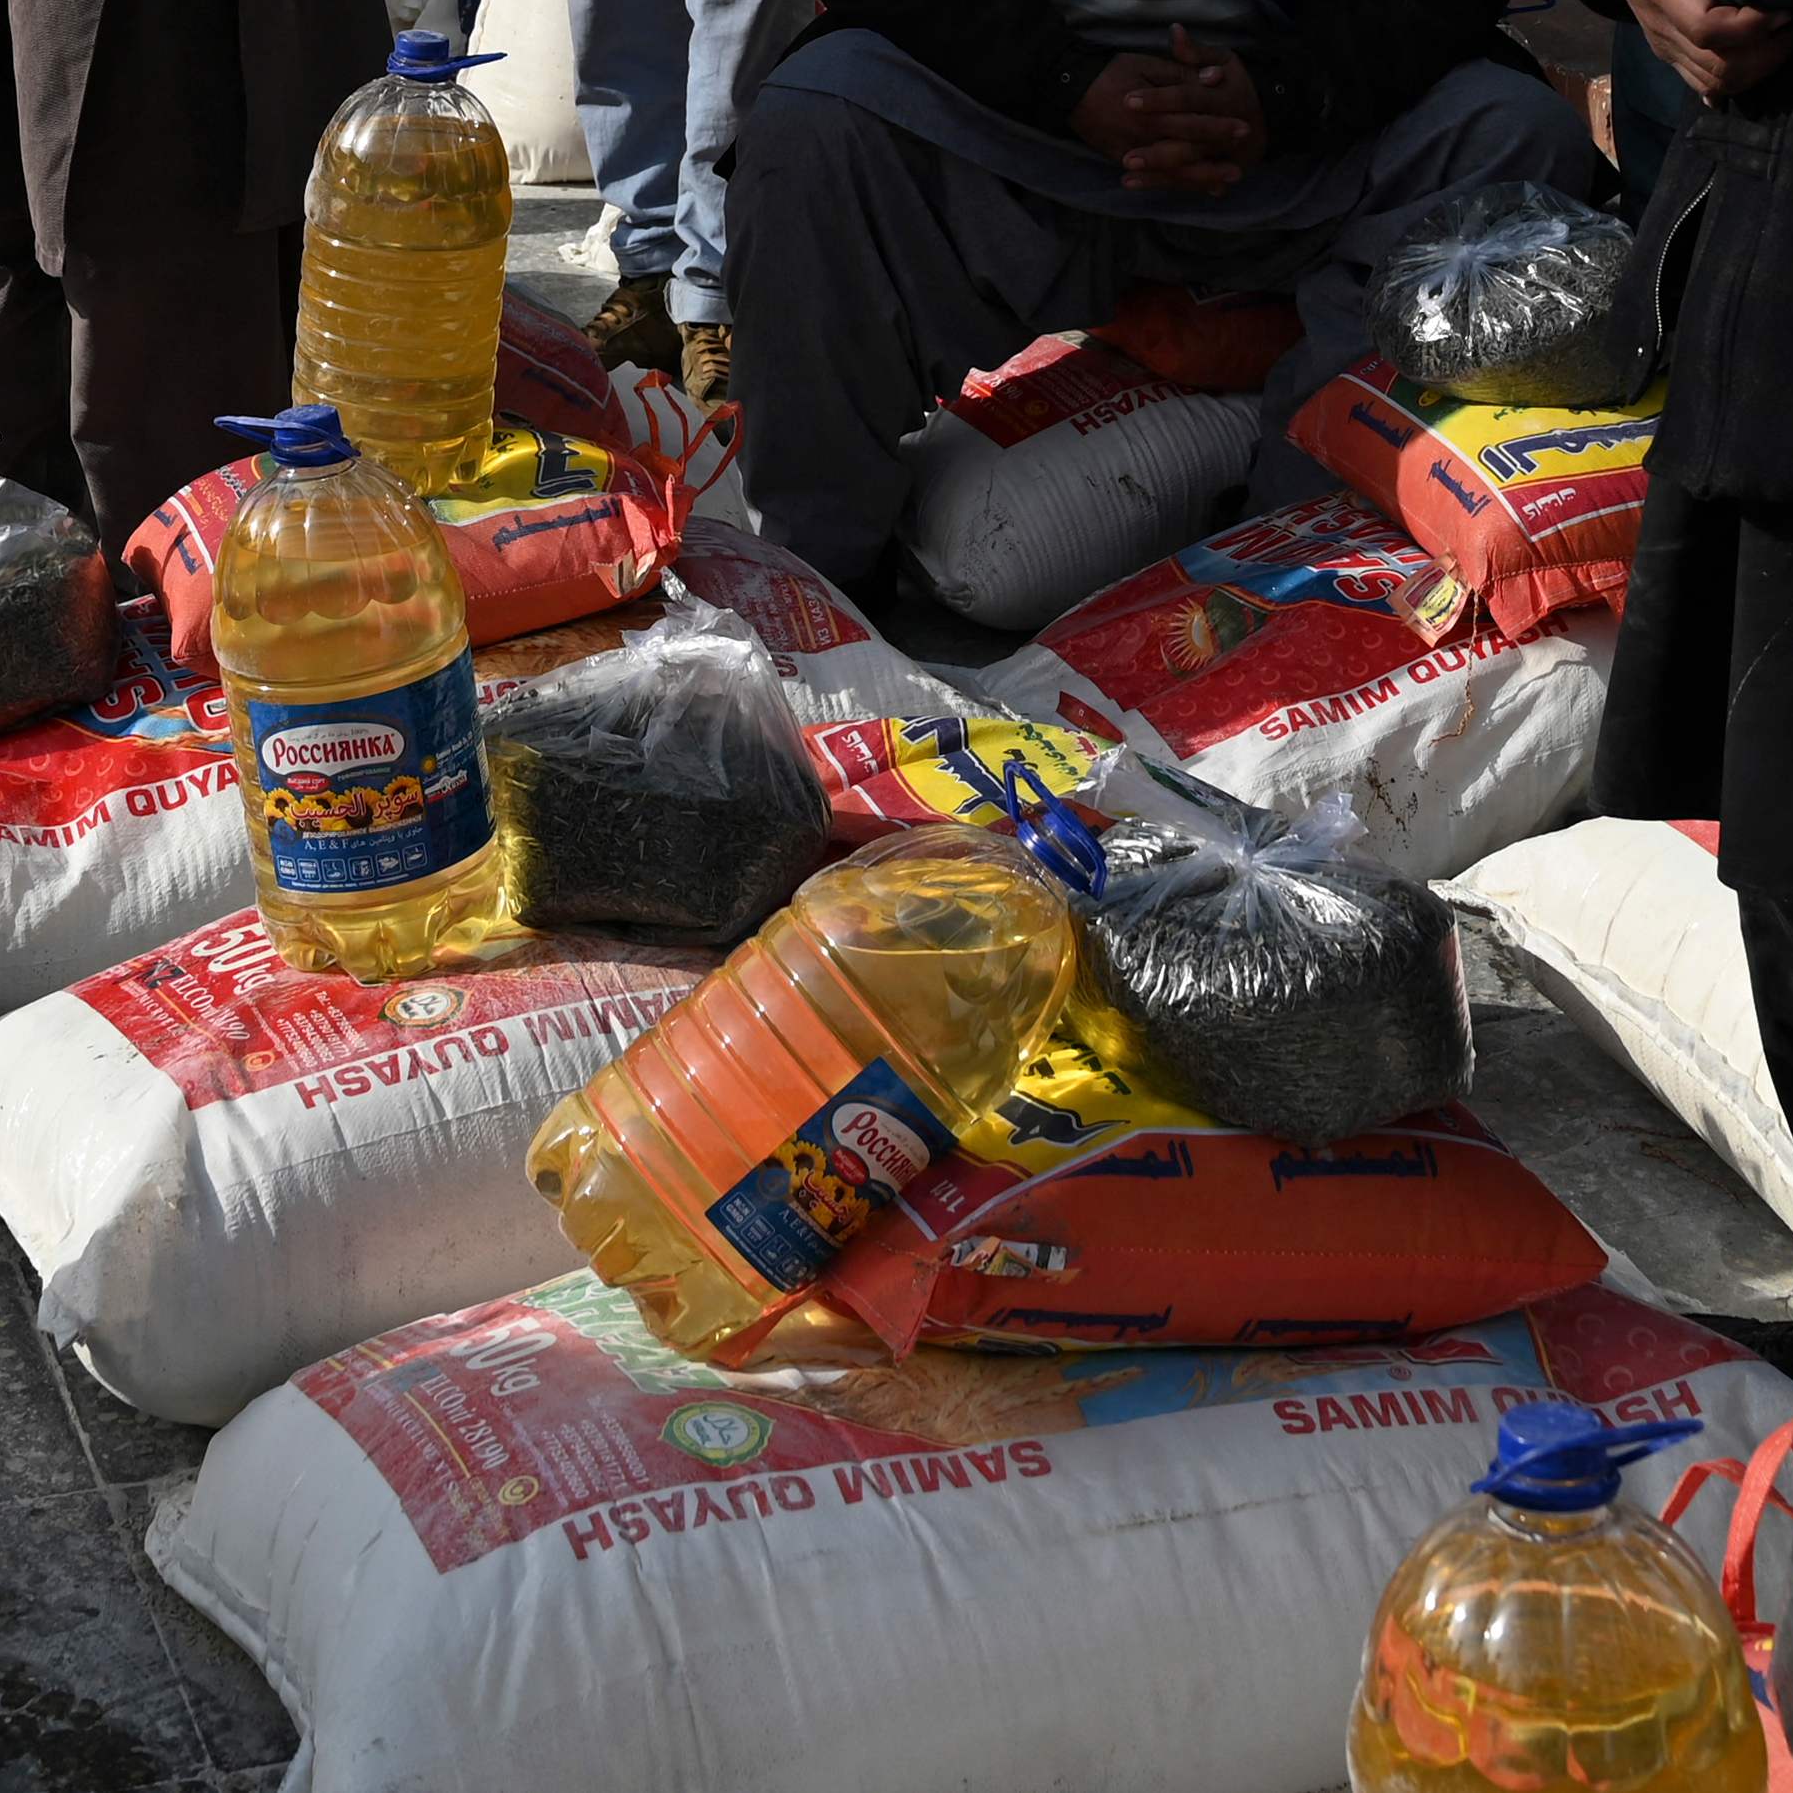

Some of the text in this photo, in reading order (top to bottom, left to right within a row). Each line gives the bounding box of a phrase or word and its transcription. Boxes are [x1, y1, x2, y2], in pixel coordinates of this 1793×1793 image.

[1258, 615, 1569, 742] SAMIM QUYASH
[272, 732, 396, 768] РОССИЯНКА
[125, 761, 240, 818] QUYA
[293, 1023, 511, 1110] QUYASH
[840, 1110, 919, 1187] РОССИЯ
[1268, 1141, 1438, 1192] المسلم
[449, 1316, 559, 1397] 50kg
[1272, 1386, 1481, 1437] SAMIM
[560, 1440, 1054, 1562] SAMIM QUYASH
